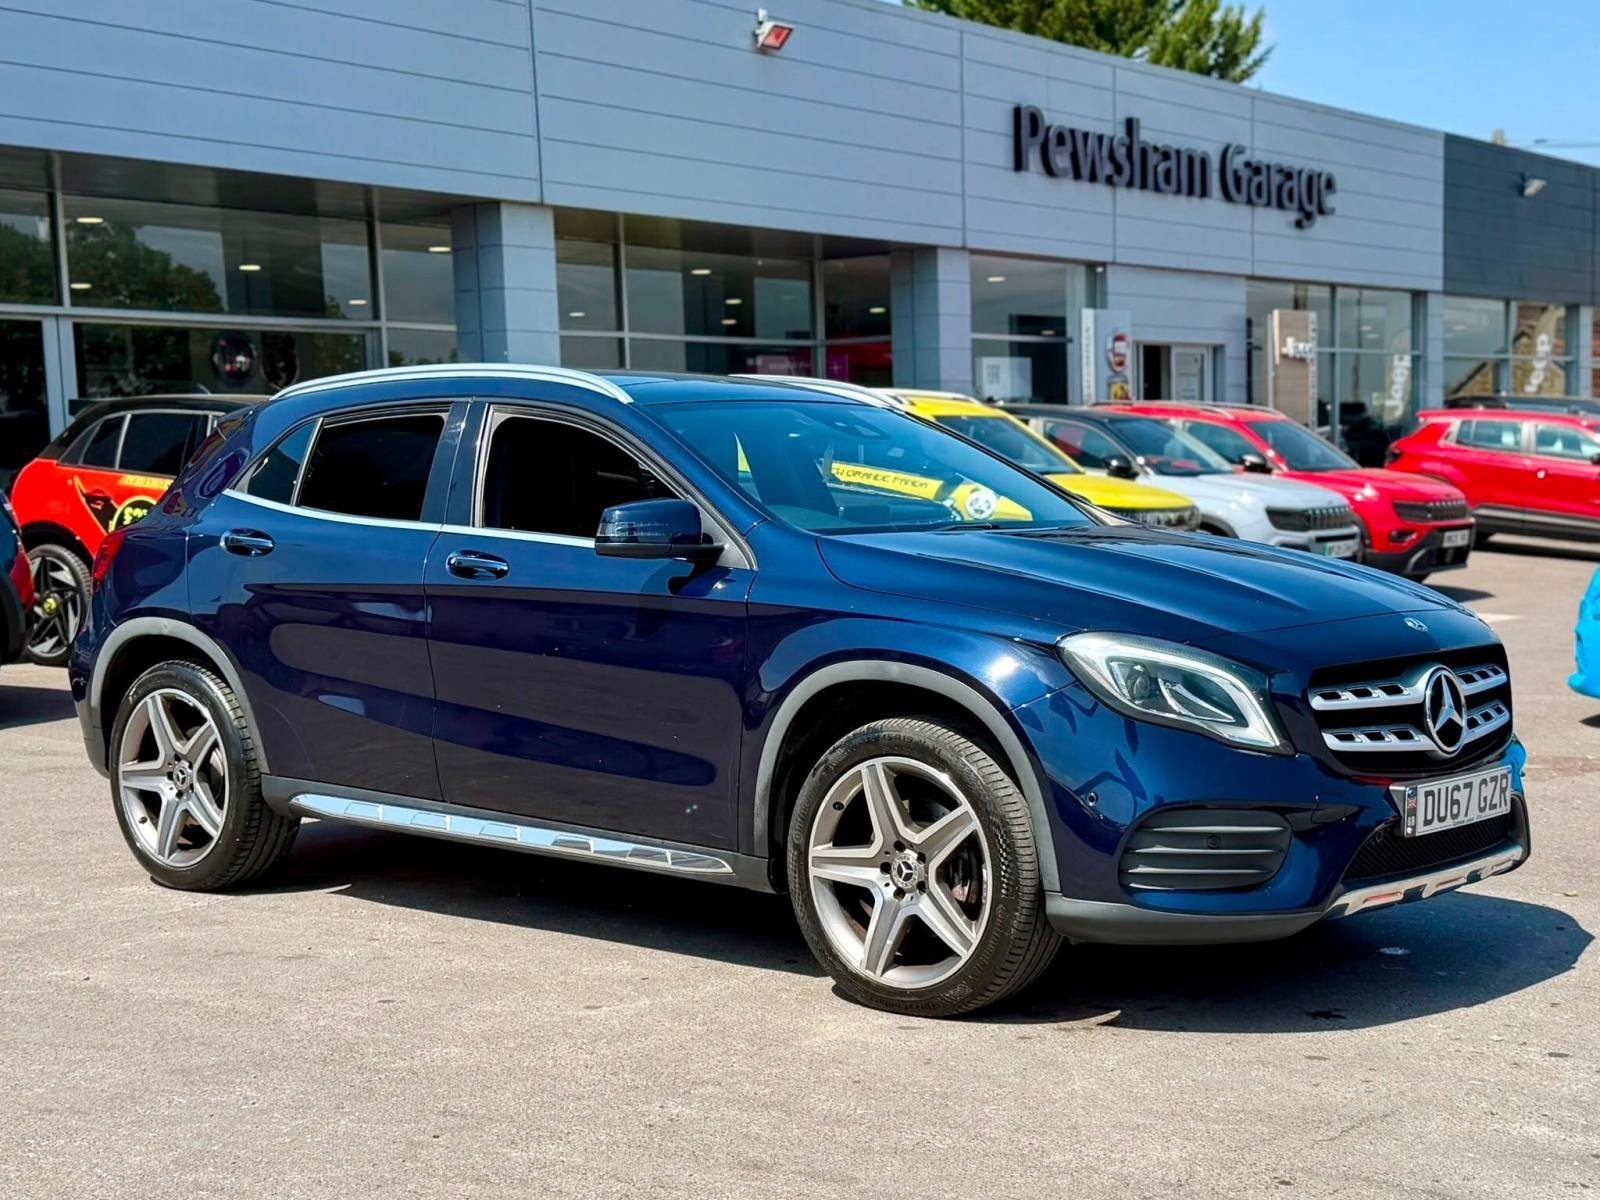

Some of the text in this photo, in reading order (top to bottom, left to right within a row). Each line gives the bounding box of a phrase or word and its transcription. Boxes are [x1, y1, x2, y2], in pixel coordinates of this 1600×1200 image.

[1013, 103, 1337, 229] Pewsham Garage
[1384, 354, 1412, 418] Jeep
[1423, 773, 1508, 826] DU67 GZR
